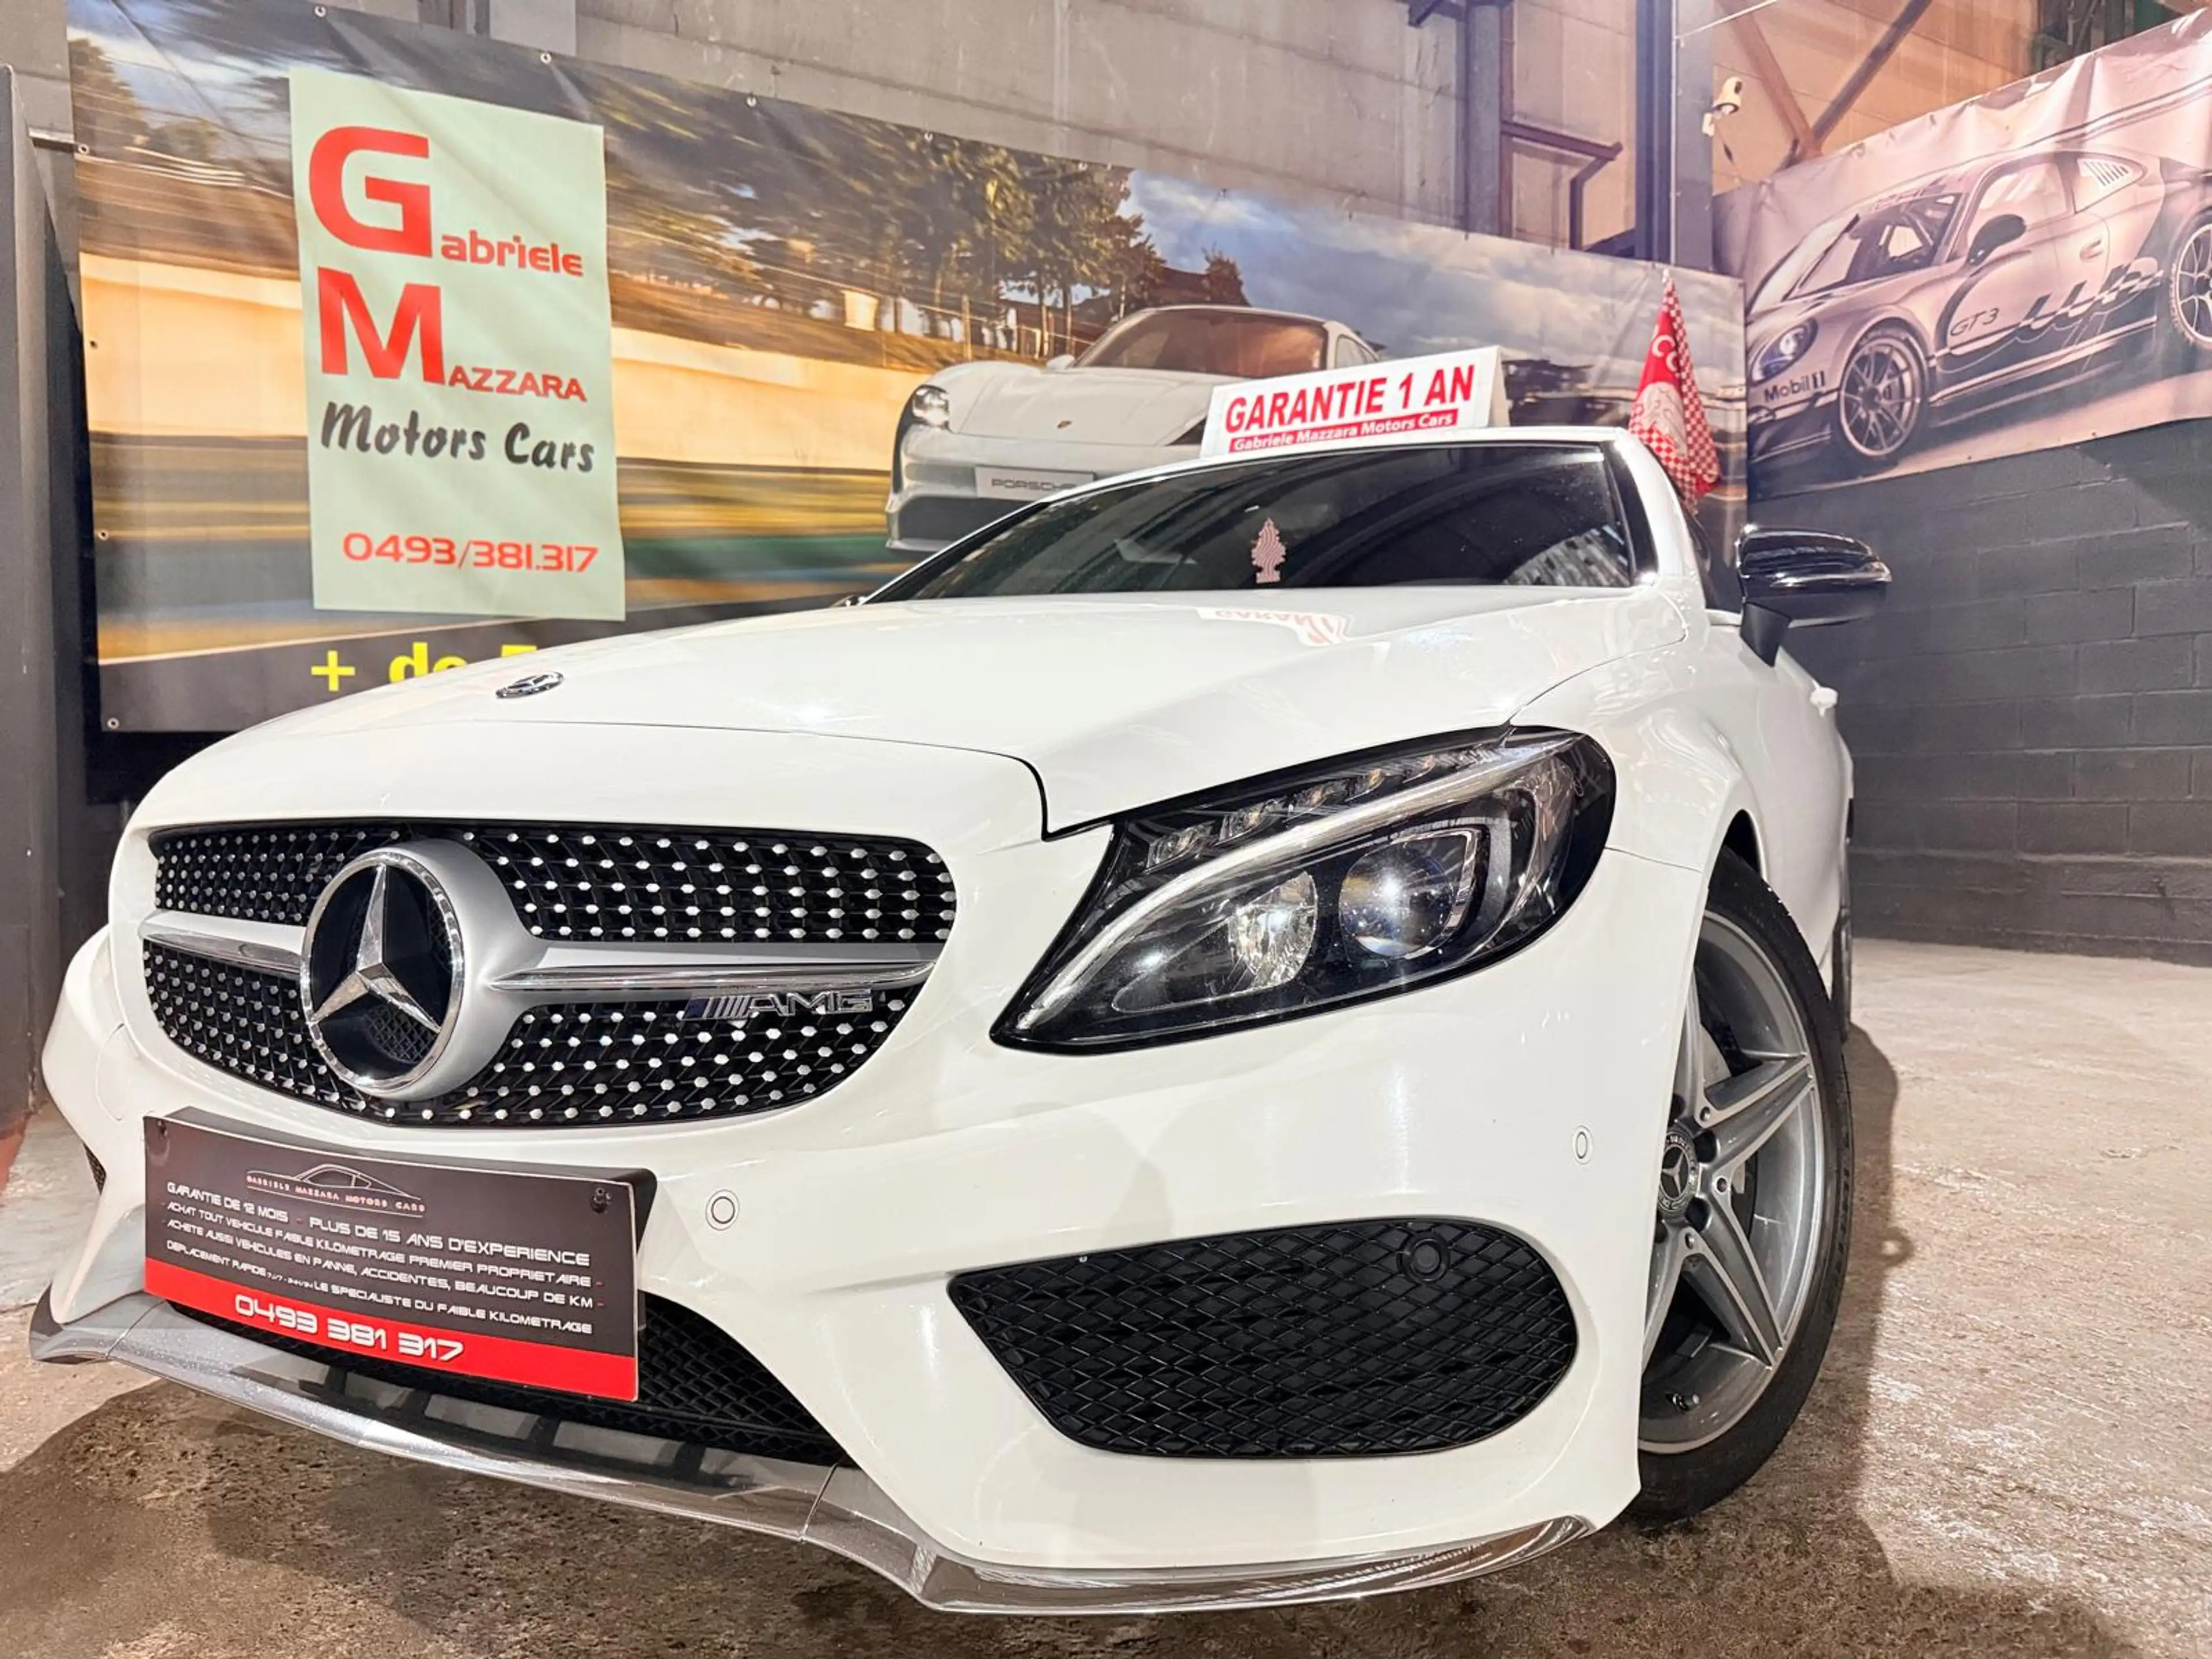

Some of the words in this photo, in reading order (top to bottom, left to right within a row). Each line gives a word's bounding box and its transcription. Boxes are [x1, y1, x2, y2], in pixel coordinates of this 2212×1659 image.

[1225, 377, 1388, 433] GARANTIE
[1399, 372, 1413, 409] 1
[1423, 364, 1475, 407] AN
[1764, 375, 1810, 403] Mobil
[320, 402, 486, 460] Motors
[505, 422, 594, 473] Cars
[1234, 433, 1295, 451] Gabriele
[1297, 427, 1358, 444] Mazzara
[1361, 419, 1415, 436] Motors
[1419, 412, 1453, 427] Cars
[343, 532, 599, 573] 0493/381.317
[749, 988, 873, 1017] AMG
[167, 1181, 222, 1206] GARANTIE
[224, 1196, 240, 1211] DE
[243, 1202, 255, 1215] 12
[258, 1205, 289, 1223] MOIS
[309, 1216, 350, 1235] PLUS
[355, 1225, 378, 1240] DE
[382, 1229, 400, 1243] 15
[407, 1233, 443, 1249] ANS
[448, 1237, 591, 1267] D'EXPERIENCE
[346, 1195, 388, 1209] MOTORS
[395, 1201, 425, 1213] CARS
[167, 1201, 196, 1217] ACHAT
[199, 1209, 224, 1224] TOUT
[225, 1216, 273, 1237] VEHICULE
[275, 1229, 314, 1248] FAIBLE
[316, 1238, 406, 1263] KILOMETRAGE
[409, 1254, 474, 1274] PREMIER
[477, 1264, 592, 1287] PROPRIETAIRE
[167, 1219, 204, 1236] ACHETE
[206, 1229, 234, 1245] AUSSI
[235, 1236, 292, 1260] VEHICULES
[294, 1253, 311, 1265] EN
[361, 1267, 452, 1291] ACCIDENTES,
[454, 1279, 539, 1301] BEAUCOUP
[543, 1292, 566, 1305] DE
[569, 1295, 593, 1309] KM
[166, 1240, 231, 1266] DEPLACEMENT
[232, 1259, 266, 1277] RAPIDE
[314, 1280, 329, 1293] LE
[331, 1284, 412, 1308] SPECIALISTE
[414, 1300, 434, 1313] DU
[437, 1302, 486, 1319] FAIBLE
[489, 1311, 593, 1335] KILOMETRAGE
[235, 1294, 318, 1334] 0493
[327, 1317, 388, 1350] 381
[398, 1331, 464, 1361] 317
